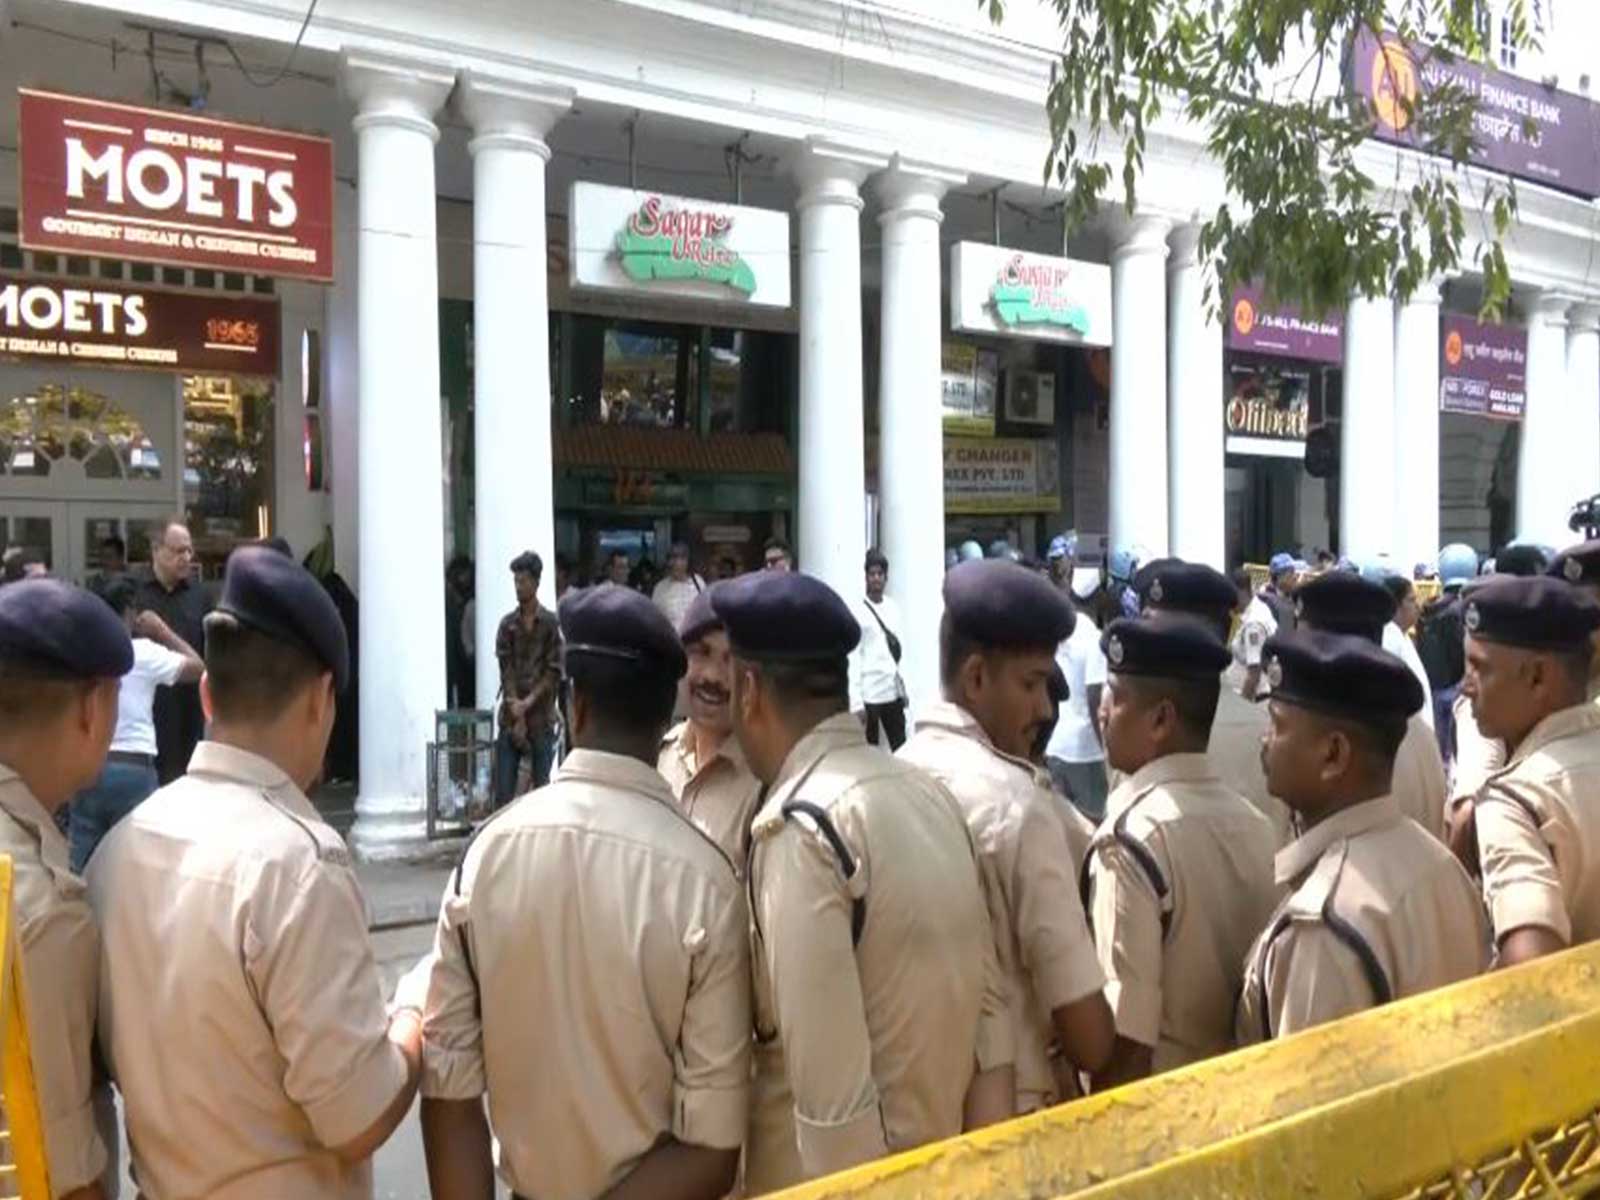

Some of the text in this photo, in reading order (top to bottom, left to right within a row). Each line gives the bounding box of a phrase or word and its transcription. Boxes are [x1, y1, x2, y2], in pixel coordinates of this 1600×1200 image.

[1481, 82, 1529, 116] FINANCE
[1530, 100, 1560, 125] BANK
[65, 138, 298, 228] MOETS
[123, 225, 181, 247] INDIAN
[181, 233, 195, 250] &
[206, 318, 259, 345] 1965
[59, 341, 69, 356] &
